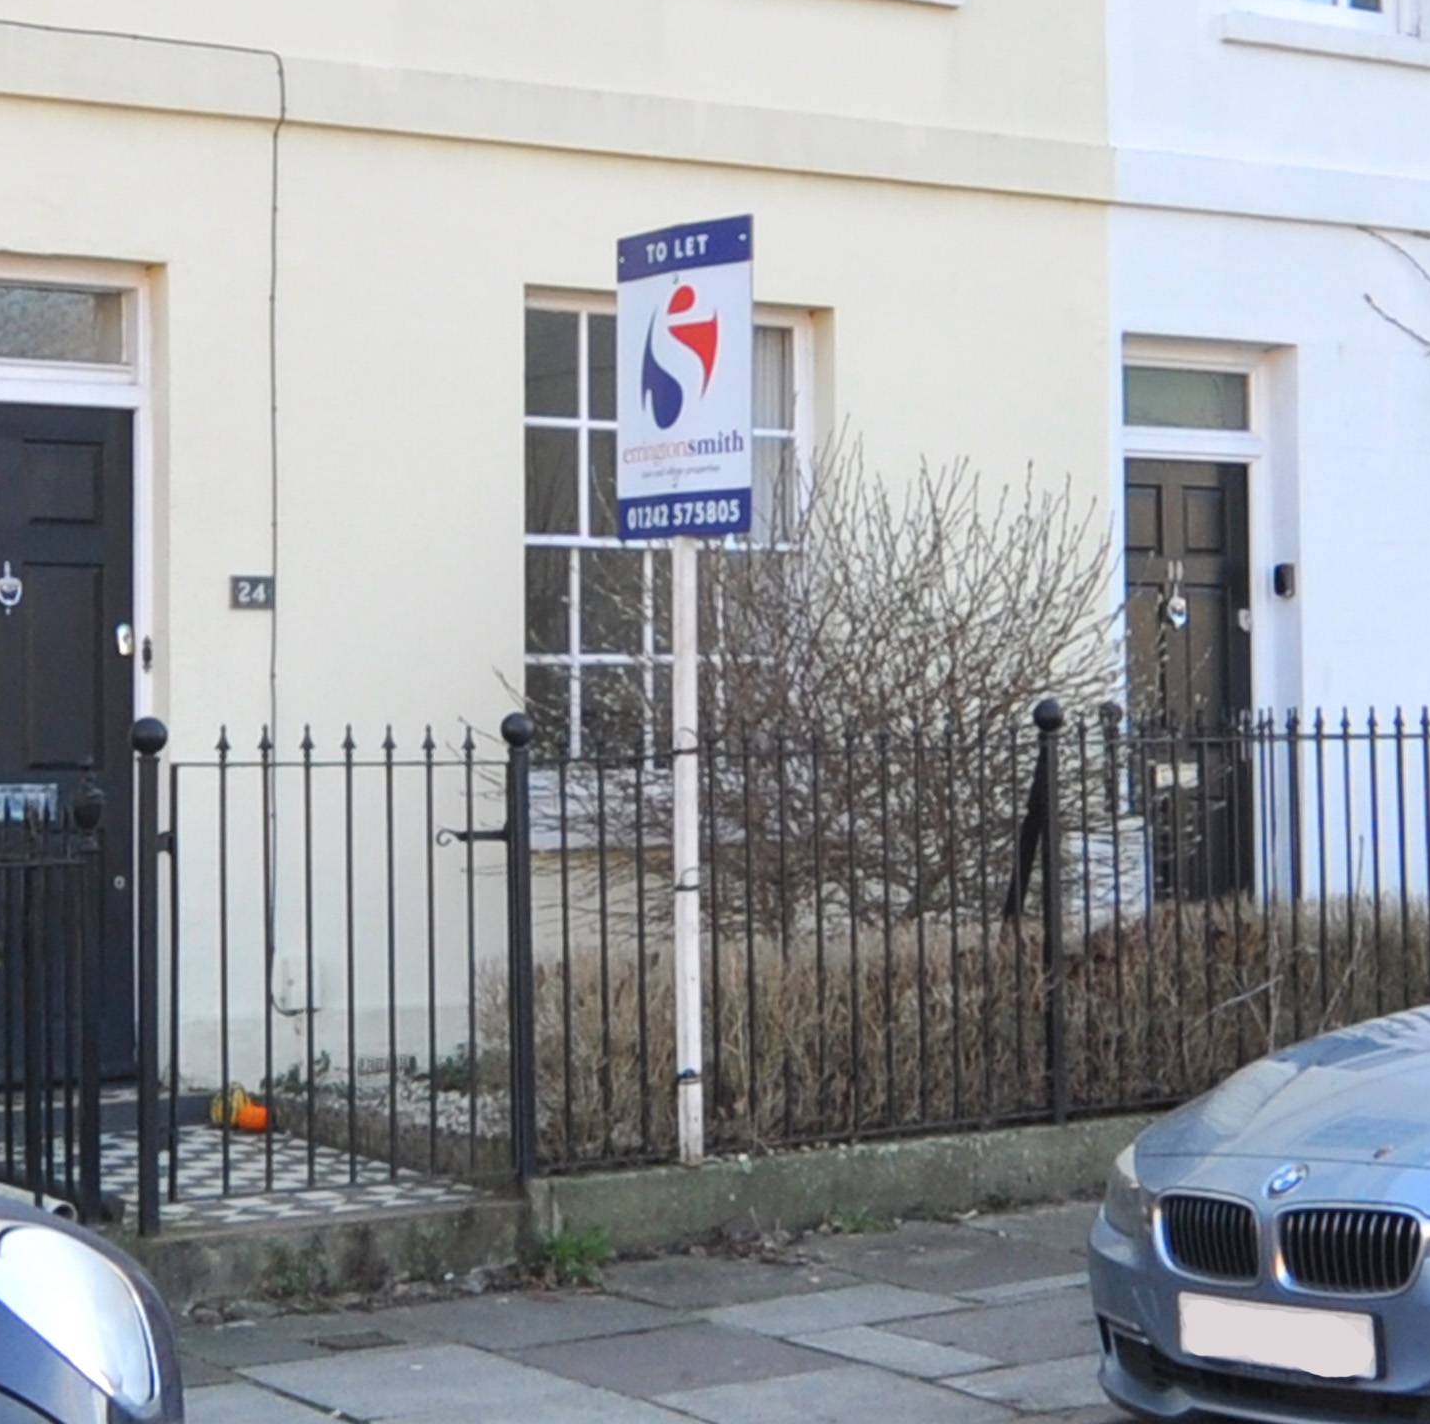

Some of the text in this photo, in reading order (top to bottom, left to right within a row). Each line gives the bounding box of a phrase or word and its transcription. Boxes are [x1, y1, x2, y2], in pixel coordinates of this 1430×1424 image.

[645, 234, 709, 264] TO LET
[627, 499, 741, 530] 01242 575805
[238, 581, 267, 603] 24
